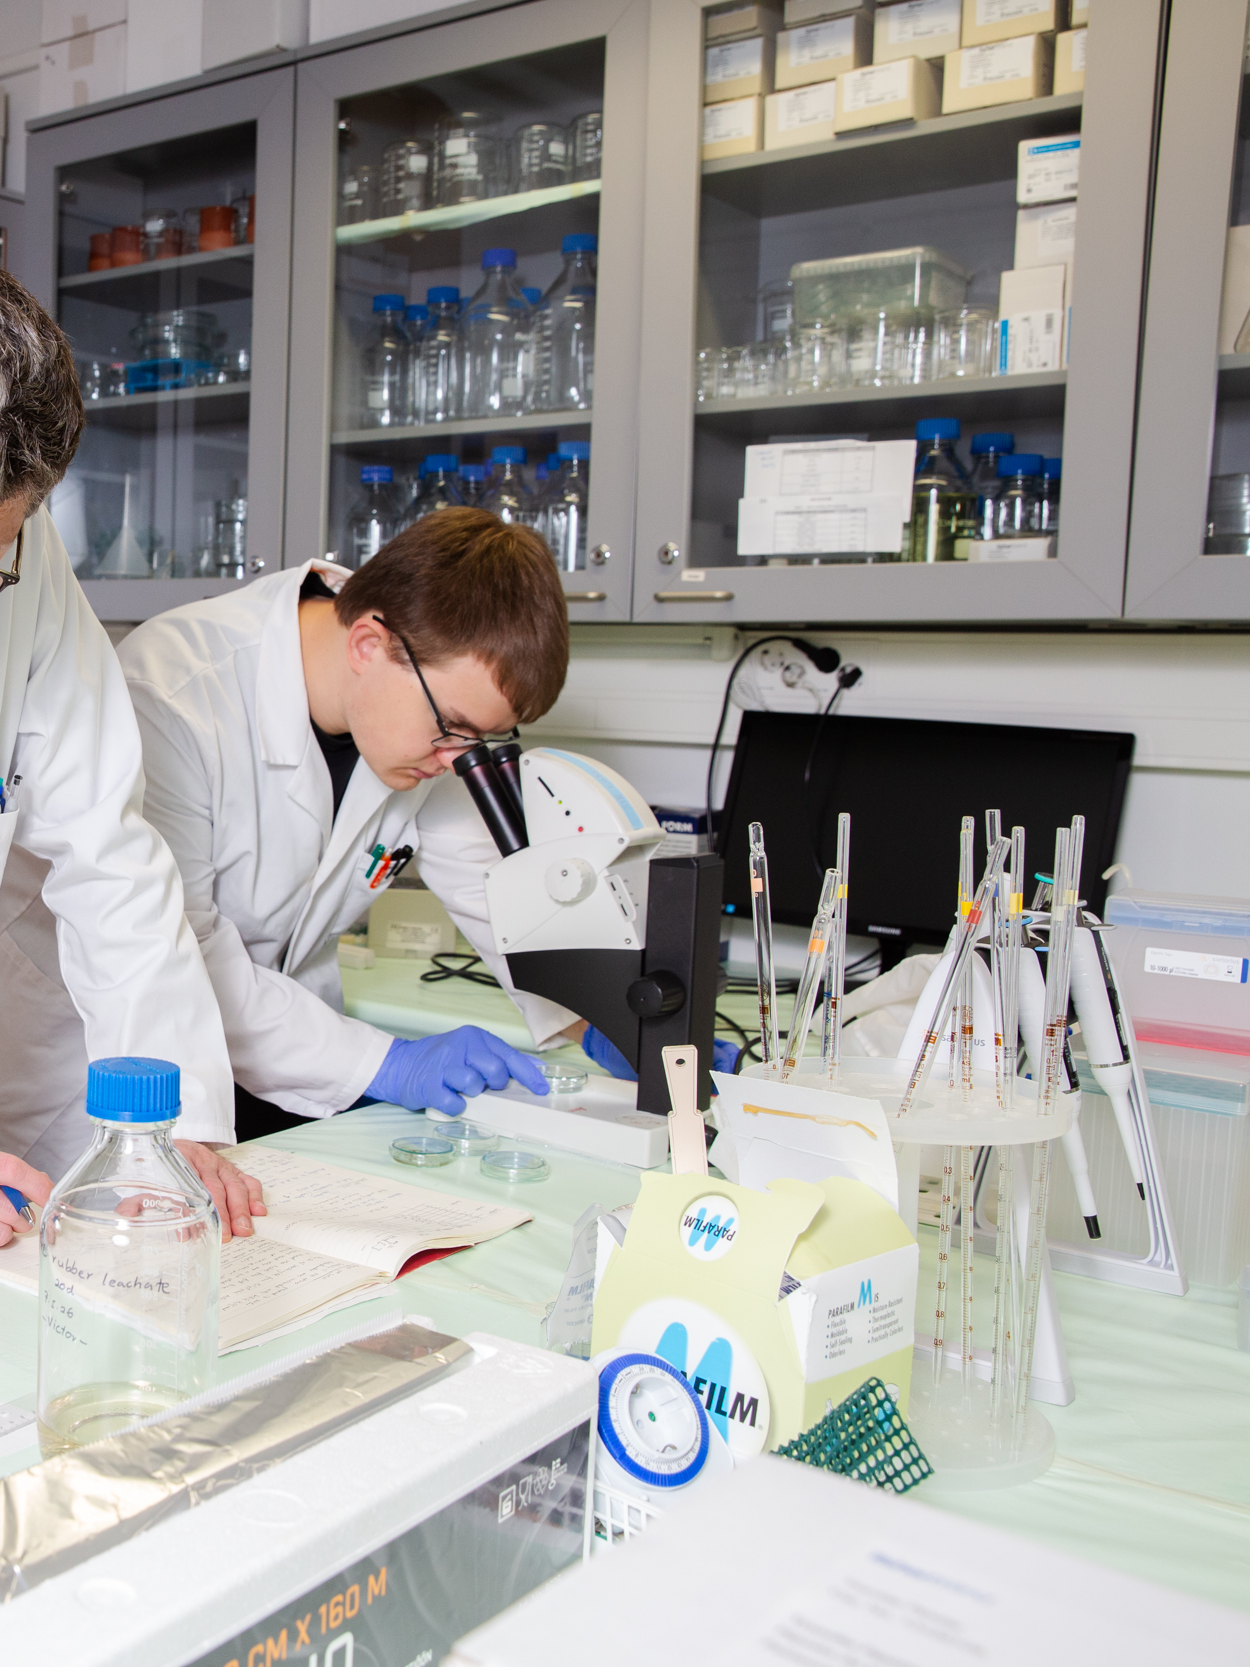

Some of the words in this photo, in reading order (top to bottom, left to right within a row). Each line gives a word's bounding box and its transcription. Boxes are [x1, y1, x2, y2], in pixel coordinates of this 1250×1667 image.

[683, 1214, 736, 1241] PARAFILM
[52, 1254, 93, 1280] rubber
[102, 1272, 170, 1294] leachate
[827, 1301, 855, 1320] PARAFILM
[857, 1278, 872, 1309] M
[680, 1370, 759, 1428] FILM
[295, 1613, 312, 1651] X
[318, 1584, 360, 1634] 160
[367, 1566, 387, 1605] M
